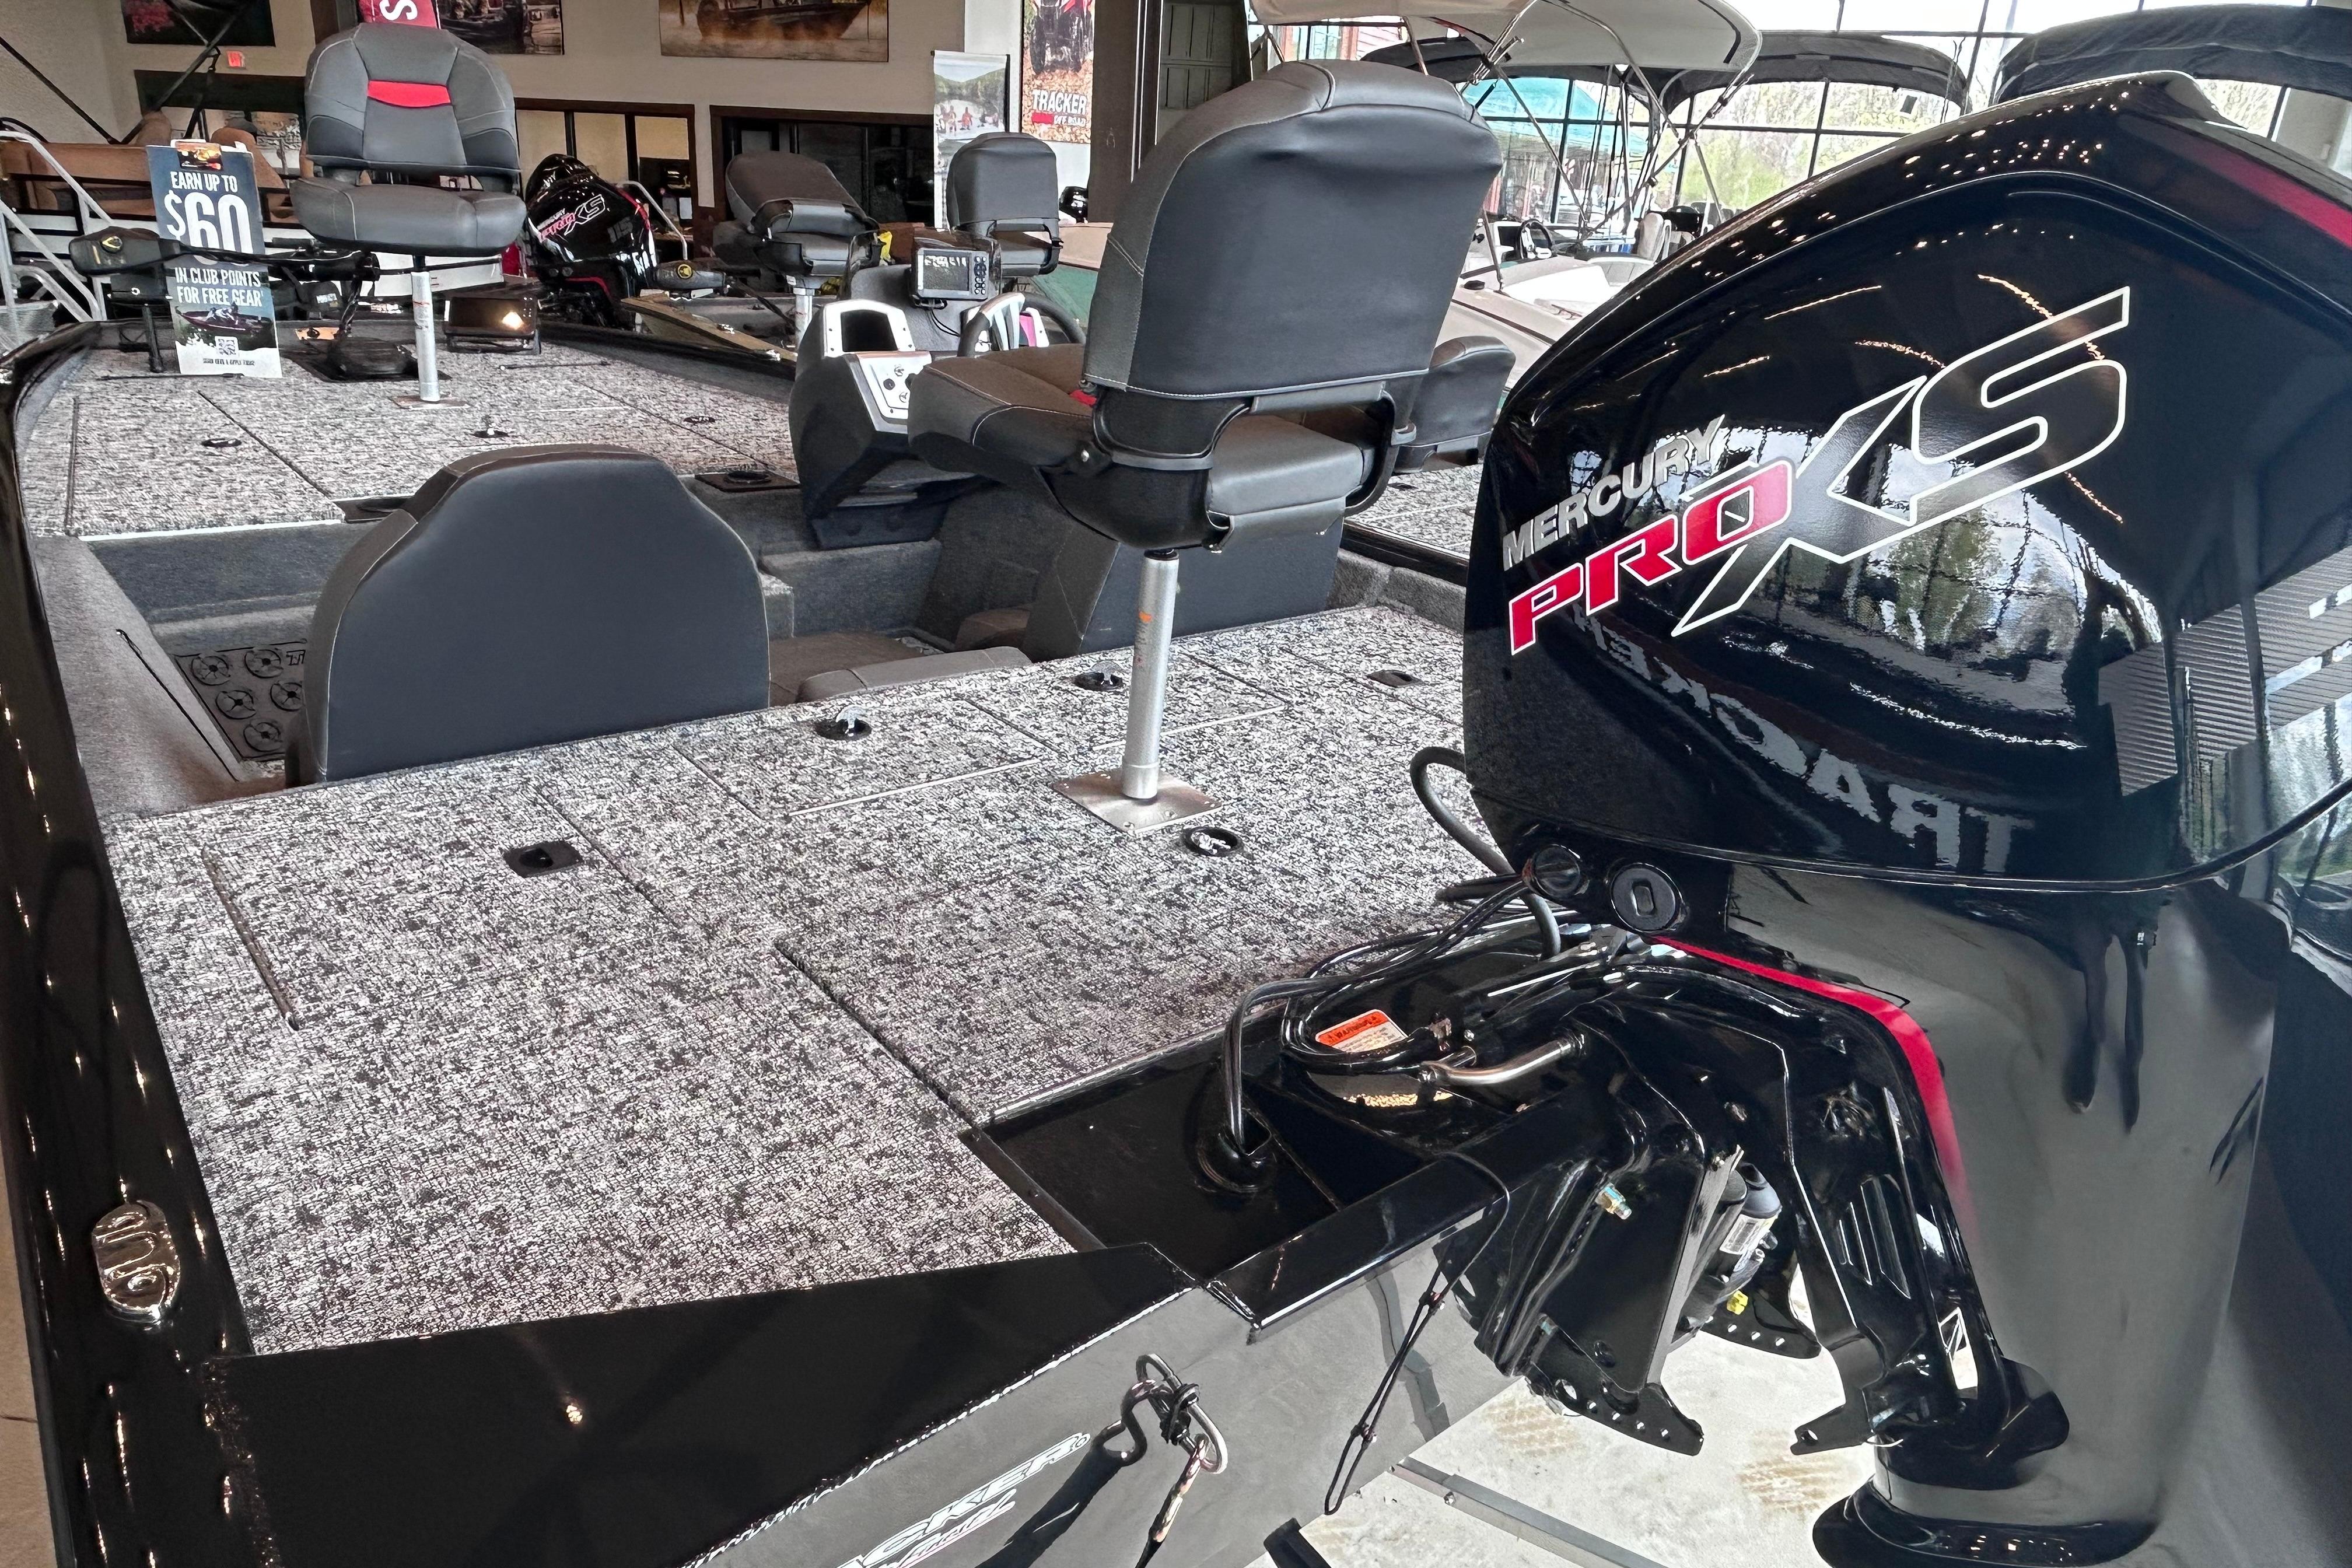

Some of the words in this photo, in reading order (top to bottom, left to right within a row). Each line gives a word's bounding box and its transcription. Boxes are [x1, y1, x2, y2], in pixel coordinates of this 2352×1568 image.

[1032, 89, 1087, 114] TRACKER
[171, 172, 204, 190] EARN
[205, 173, 220, 192] UP
[221, 174, 239, 194] TO
[164, 190, 254, 266] $60
[175, 268, 188, 284] IN
[189, 268, 219, 285] CLUB
[220, 269, 261, 288] POINTS
[177, 286, 201, 304] FOR
[201, 288, 232, 306] FREE
[1508, 459, 1792, 656] PRO
[1670, 286, 2130, 638] XS
[1503, 414, 1726, 572] MERCURY
